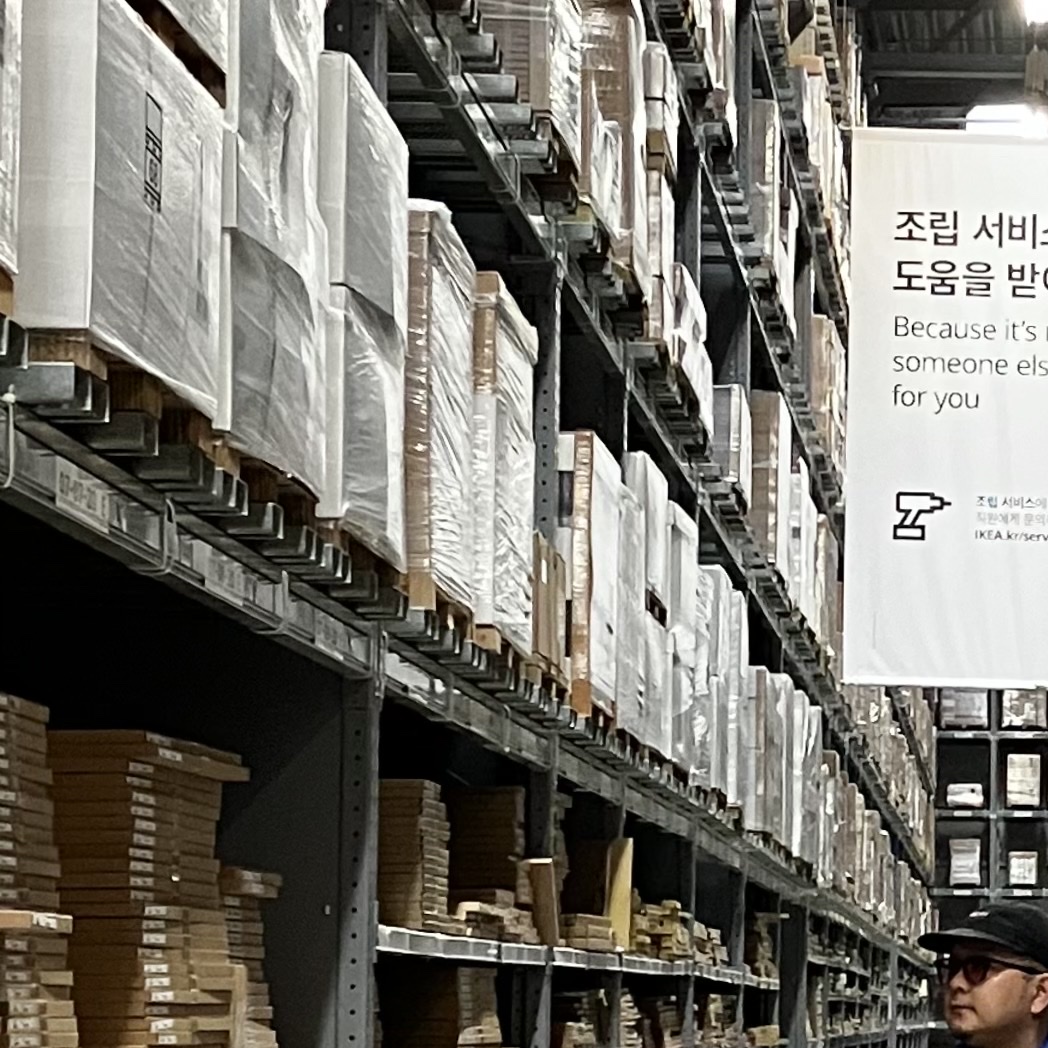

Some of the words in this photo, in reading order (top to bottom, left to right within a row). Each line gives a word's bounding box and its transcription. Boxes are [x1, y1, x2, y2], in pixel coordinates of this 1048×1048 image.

[894, 211, 958, 246] 조립
[893, 260, 995, 297] 도움을
[895, 316, 996, 340] Because
[1005, 319, 1037, 342] it’s
[893, 356, 1008, 375] someone
[892, 384, 927, 407] for
[934, 392, 979, 415] you
[976, 496, 998, 508] 조립
[1002, 496, 1047, 509] 서비스에
